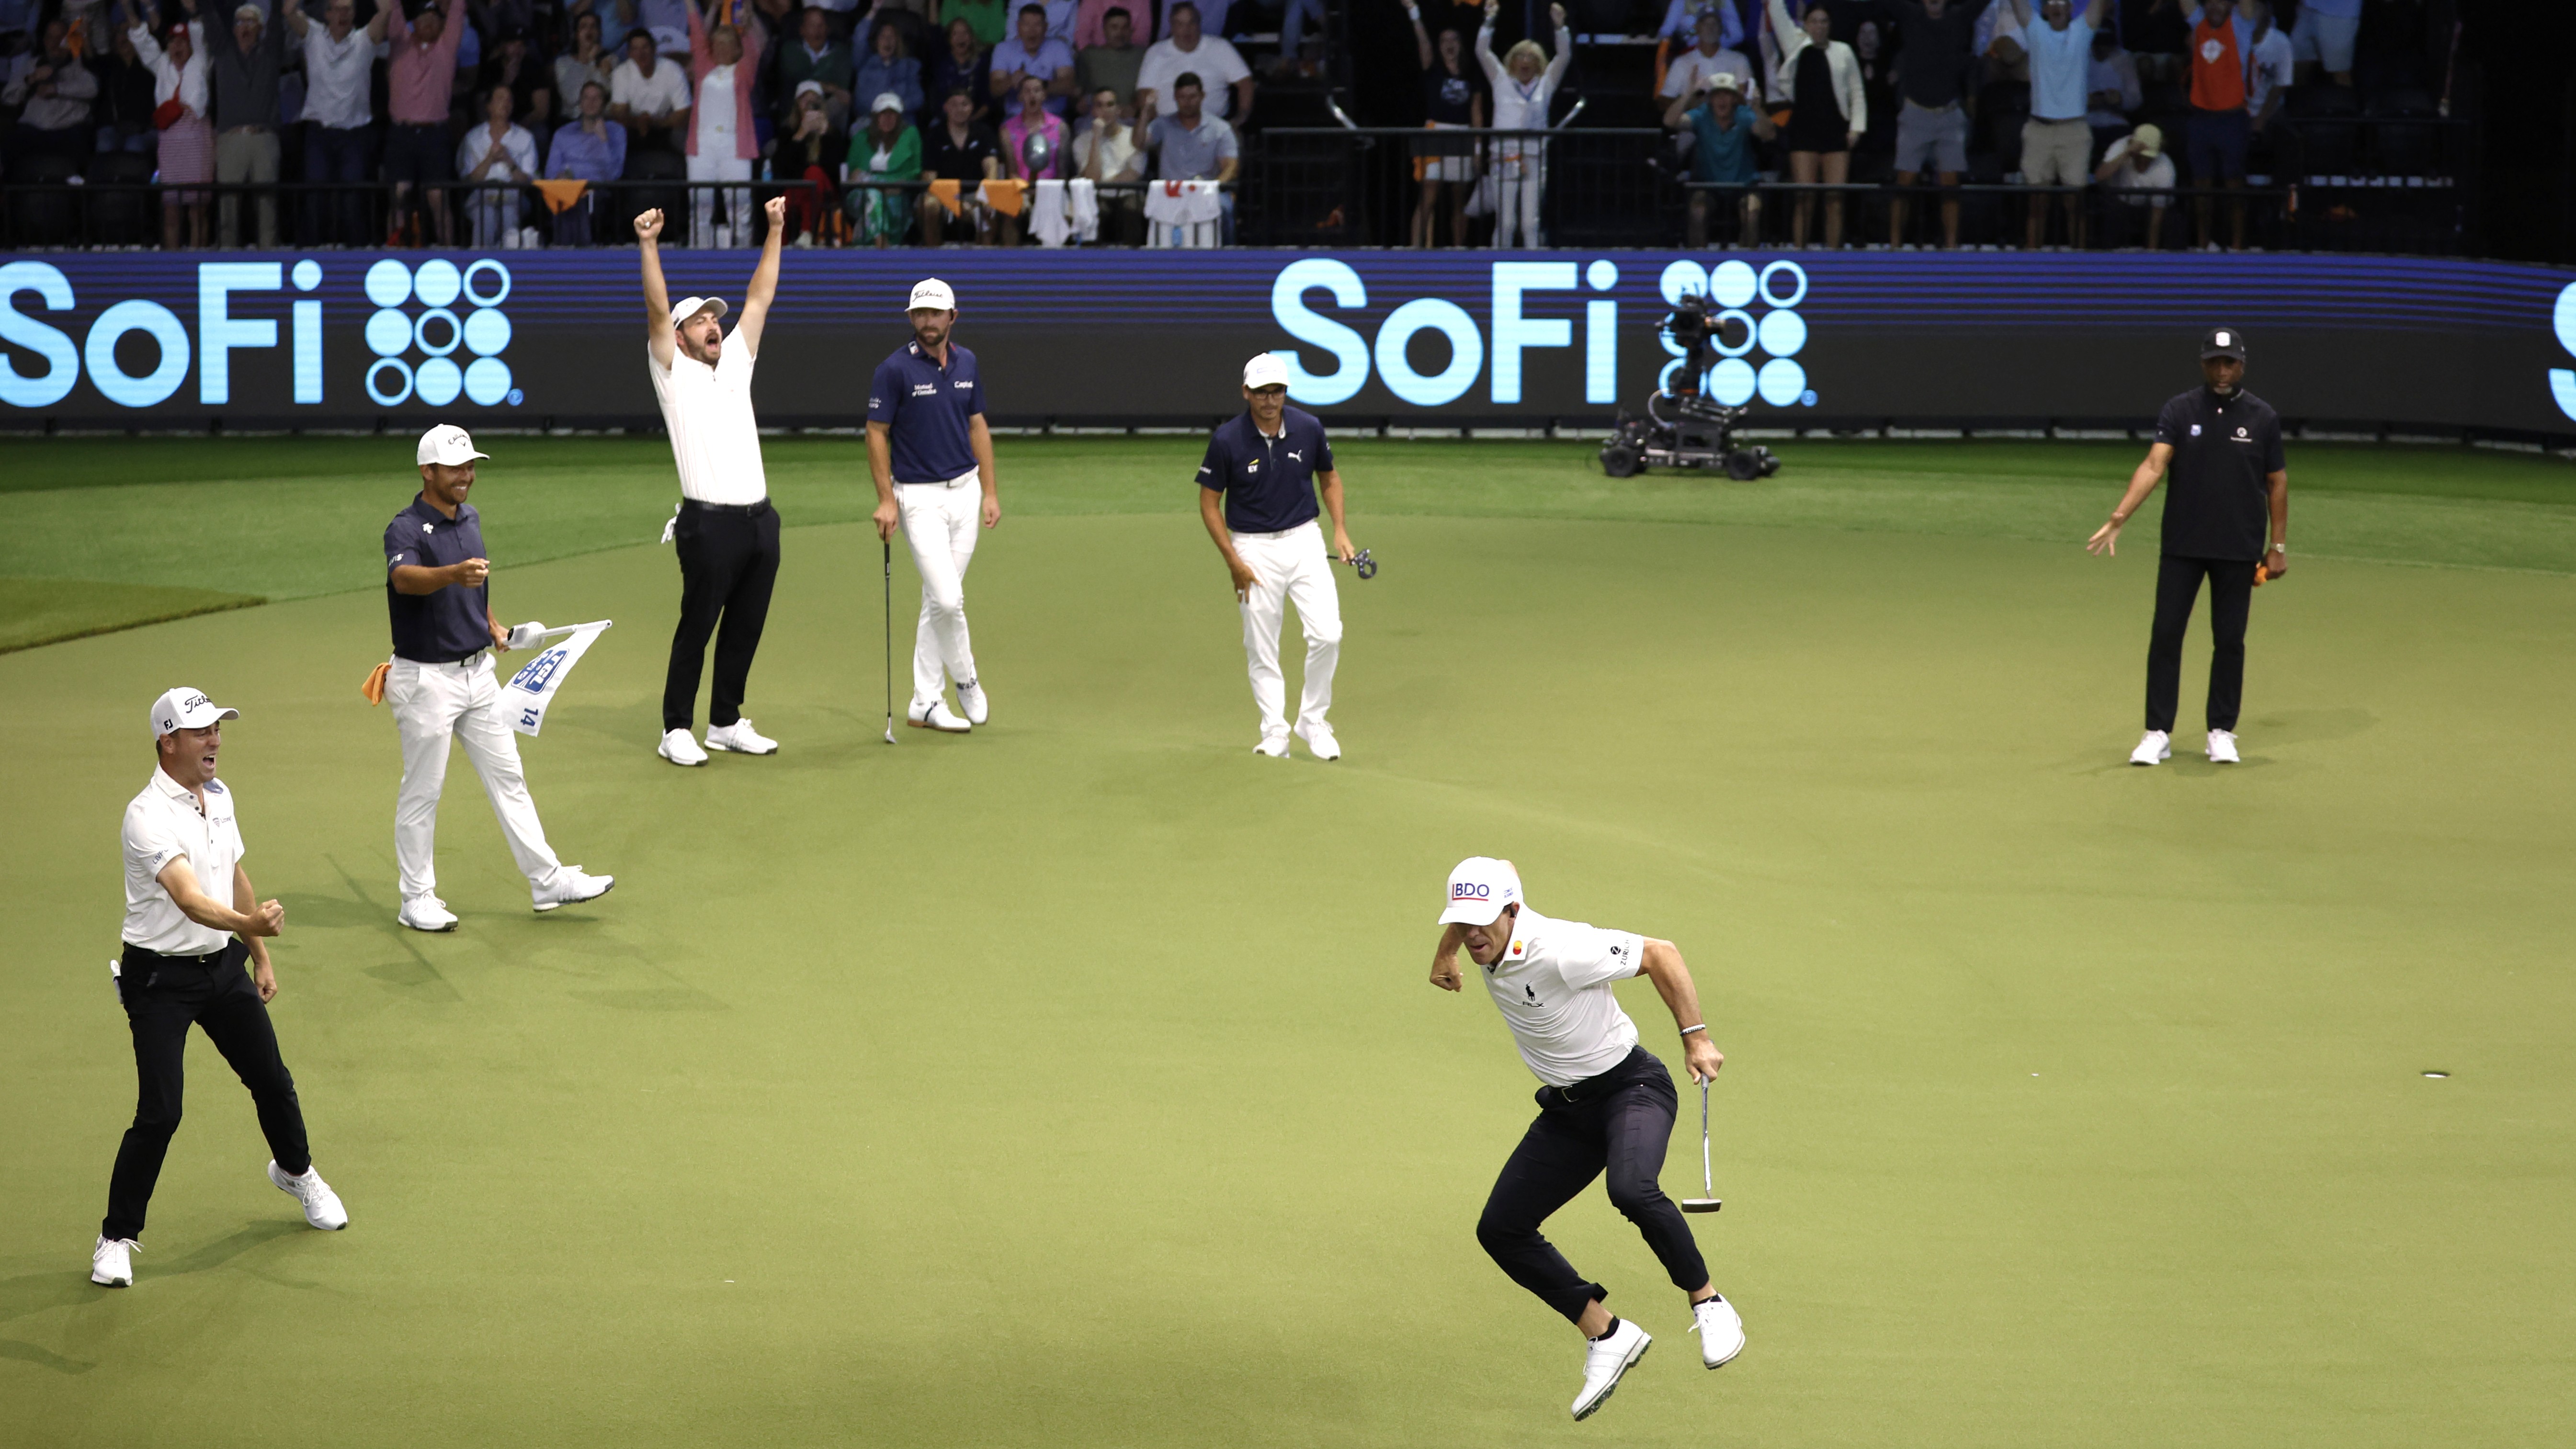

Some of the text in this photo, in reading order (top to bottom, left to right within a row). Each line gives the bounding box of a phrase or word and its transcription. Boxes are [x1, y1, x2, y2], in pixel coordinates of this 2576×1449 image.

[0, 259, 322, 407] SoFi
[1271, 258, 1618, 406] SoFi
[1248, 464, 1258, 473] EY
[164, 719, 173, 730] FJ
[521, 708, 538, 727] 14
[1455, 883, 1489, 897] BDO
[1620, 940, 1629, 965] ZURICH
